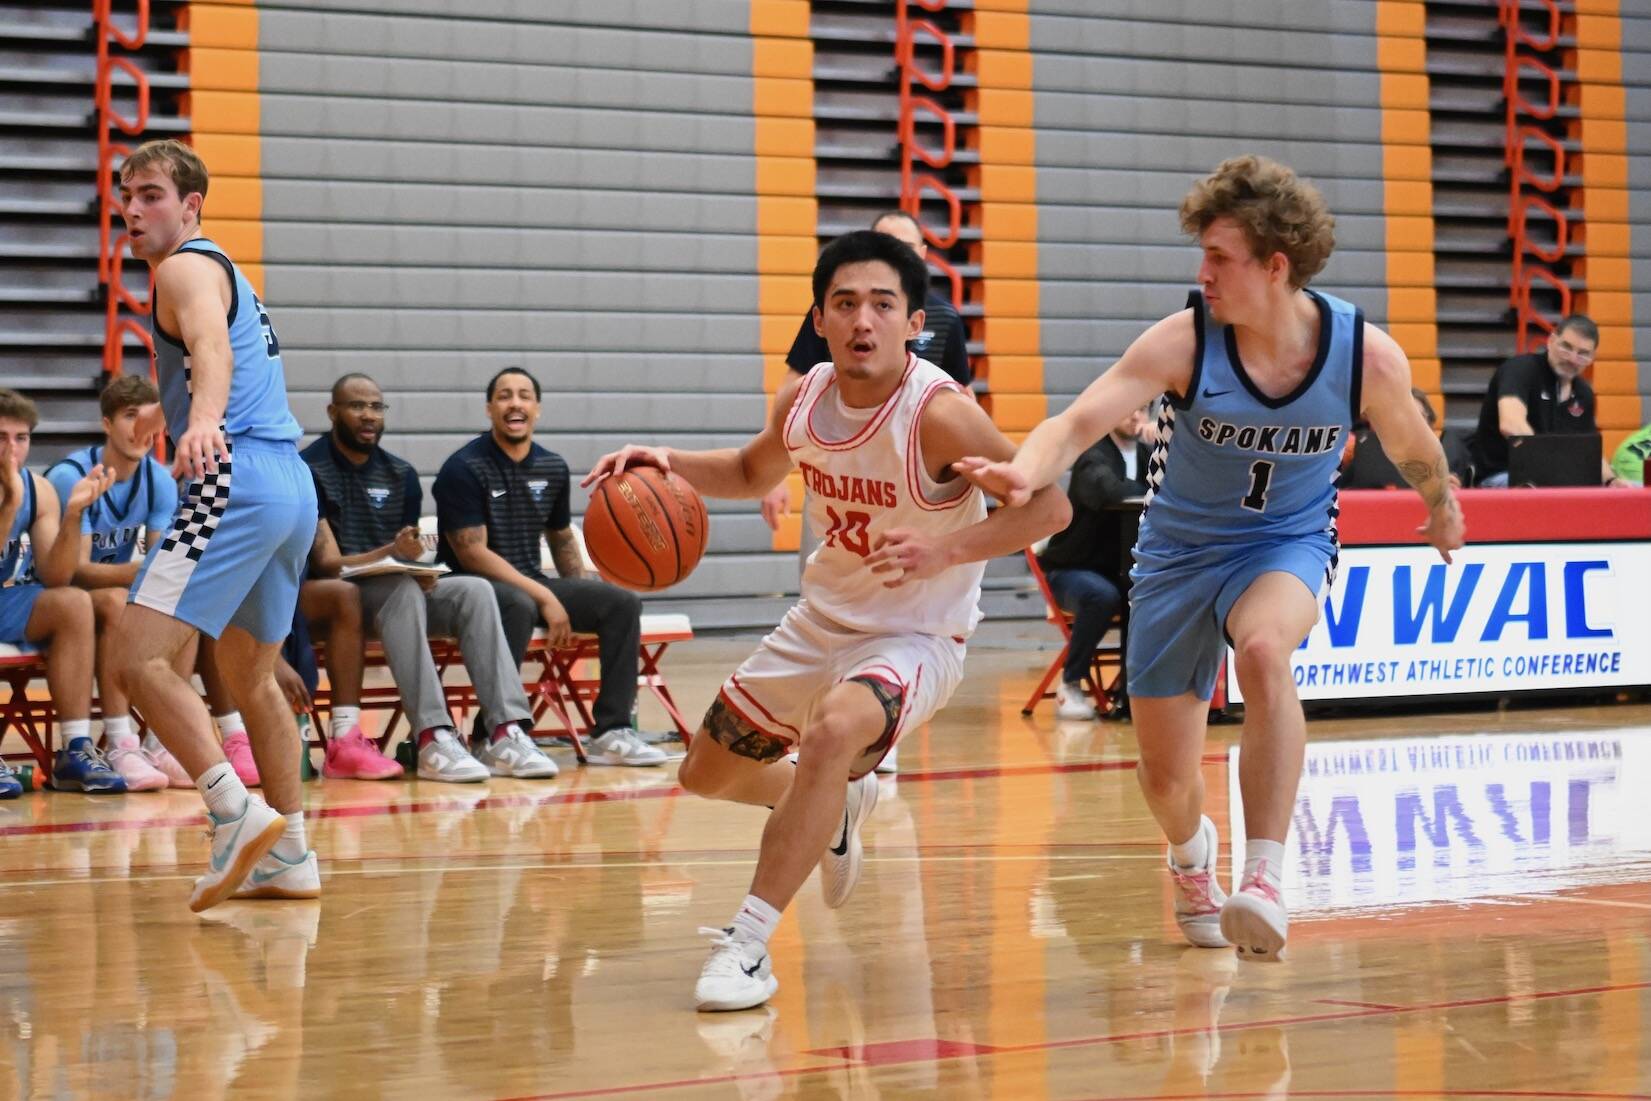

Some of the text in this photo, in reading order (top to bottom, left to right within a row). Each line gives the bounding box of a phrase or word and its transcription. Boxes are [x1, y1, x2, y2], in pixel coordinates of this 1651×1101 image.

[1199, 416, 1342, 455] SPOKANE
[799, 460, 897, 508] TROJANS
[1240, 459, 1275, 513] 1
[1294, 652, 1621, 687] ORTHWEST ATHLETIC CONFERENCE
